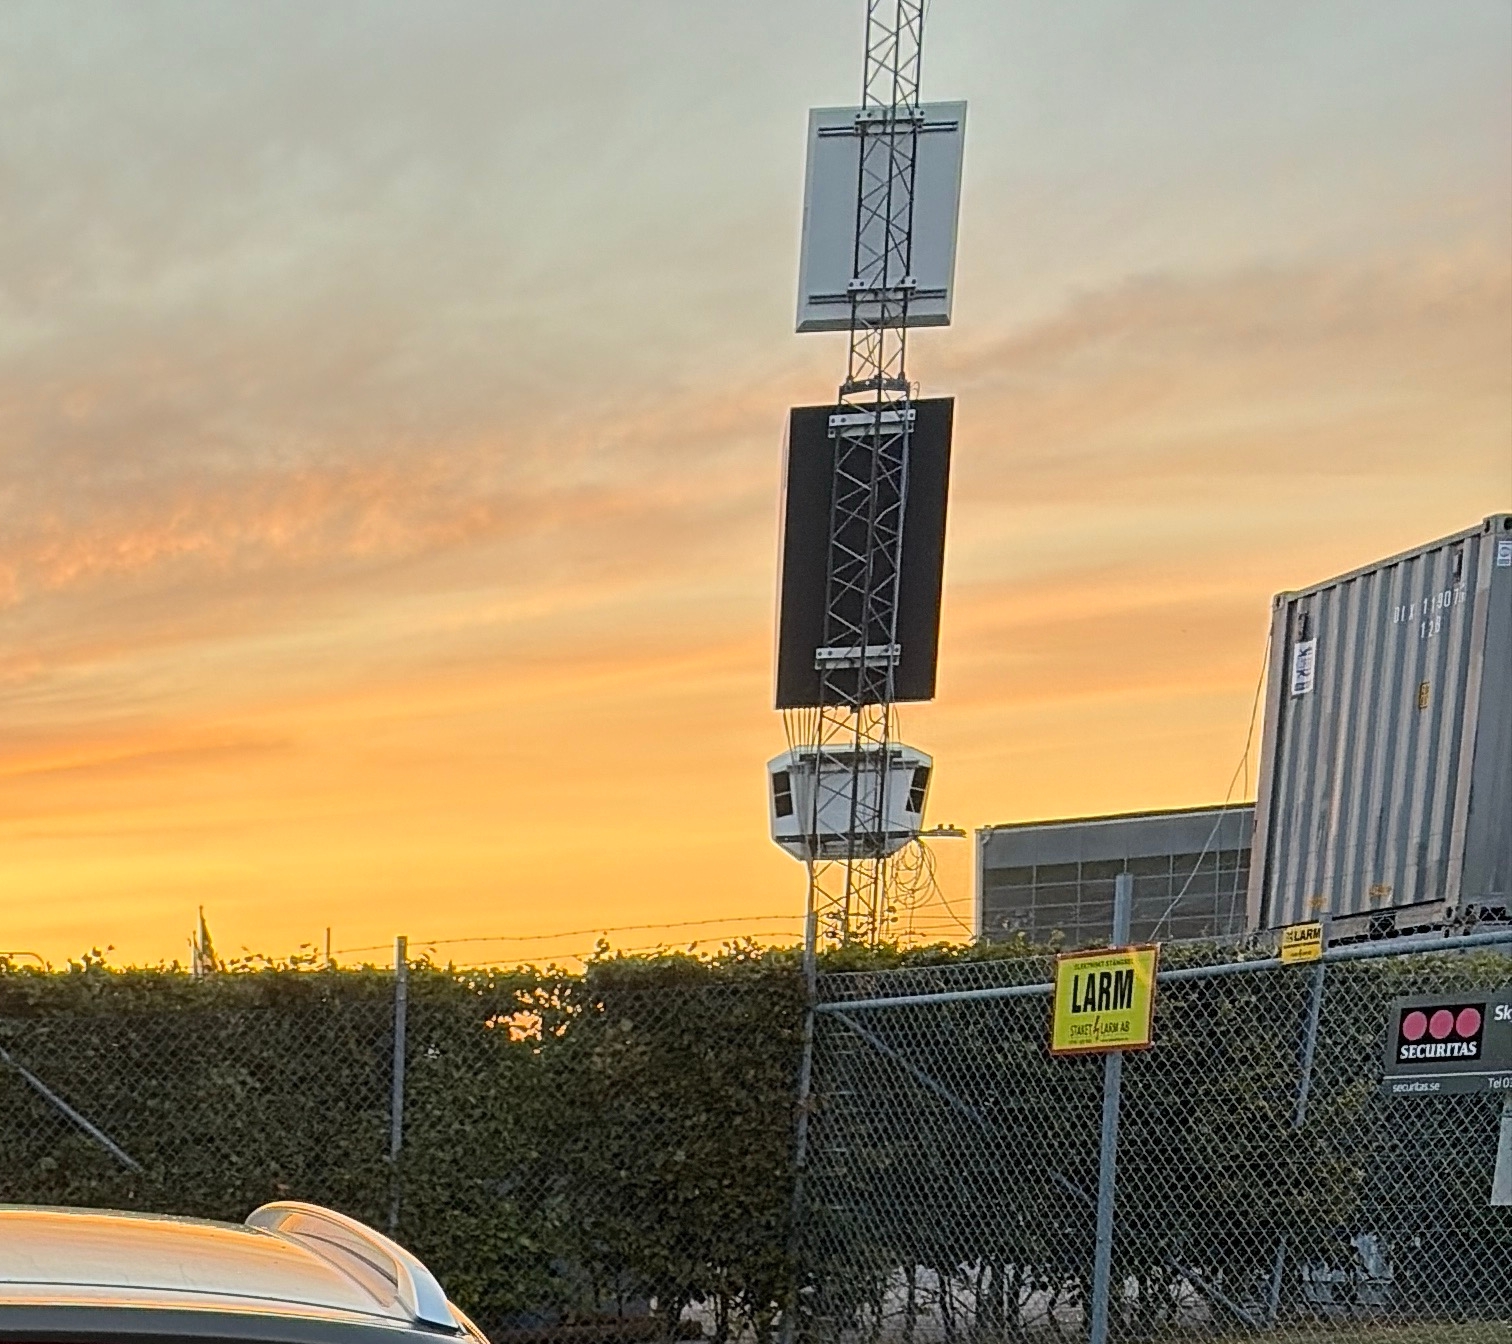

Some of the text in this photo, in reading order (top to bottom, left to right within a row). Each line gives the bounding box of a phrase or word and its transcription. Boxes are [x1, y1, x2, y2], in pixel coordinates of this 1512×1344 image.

[1293, 927, 1321, 941] LARM
[1071, 968, 1134, 1014] LARM
[1493, 1004, 1512, 1023] Sk
[1399, 1041, 1477, 1060] SECURITAS
[1392, 1082, 1441, 1093] securitas.se
[1488, 1077, 1502, 1089] Tel
